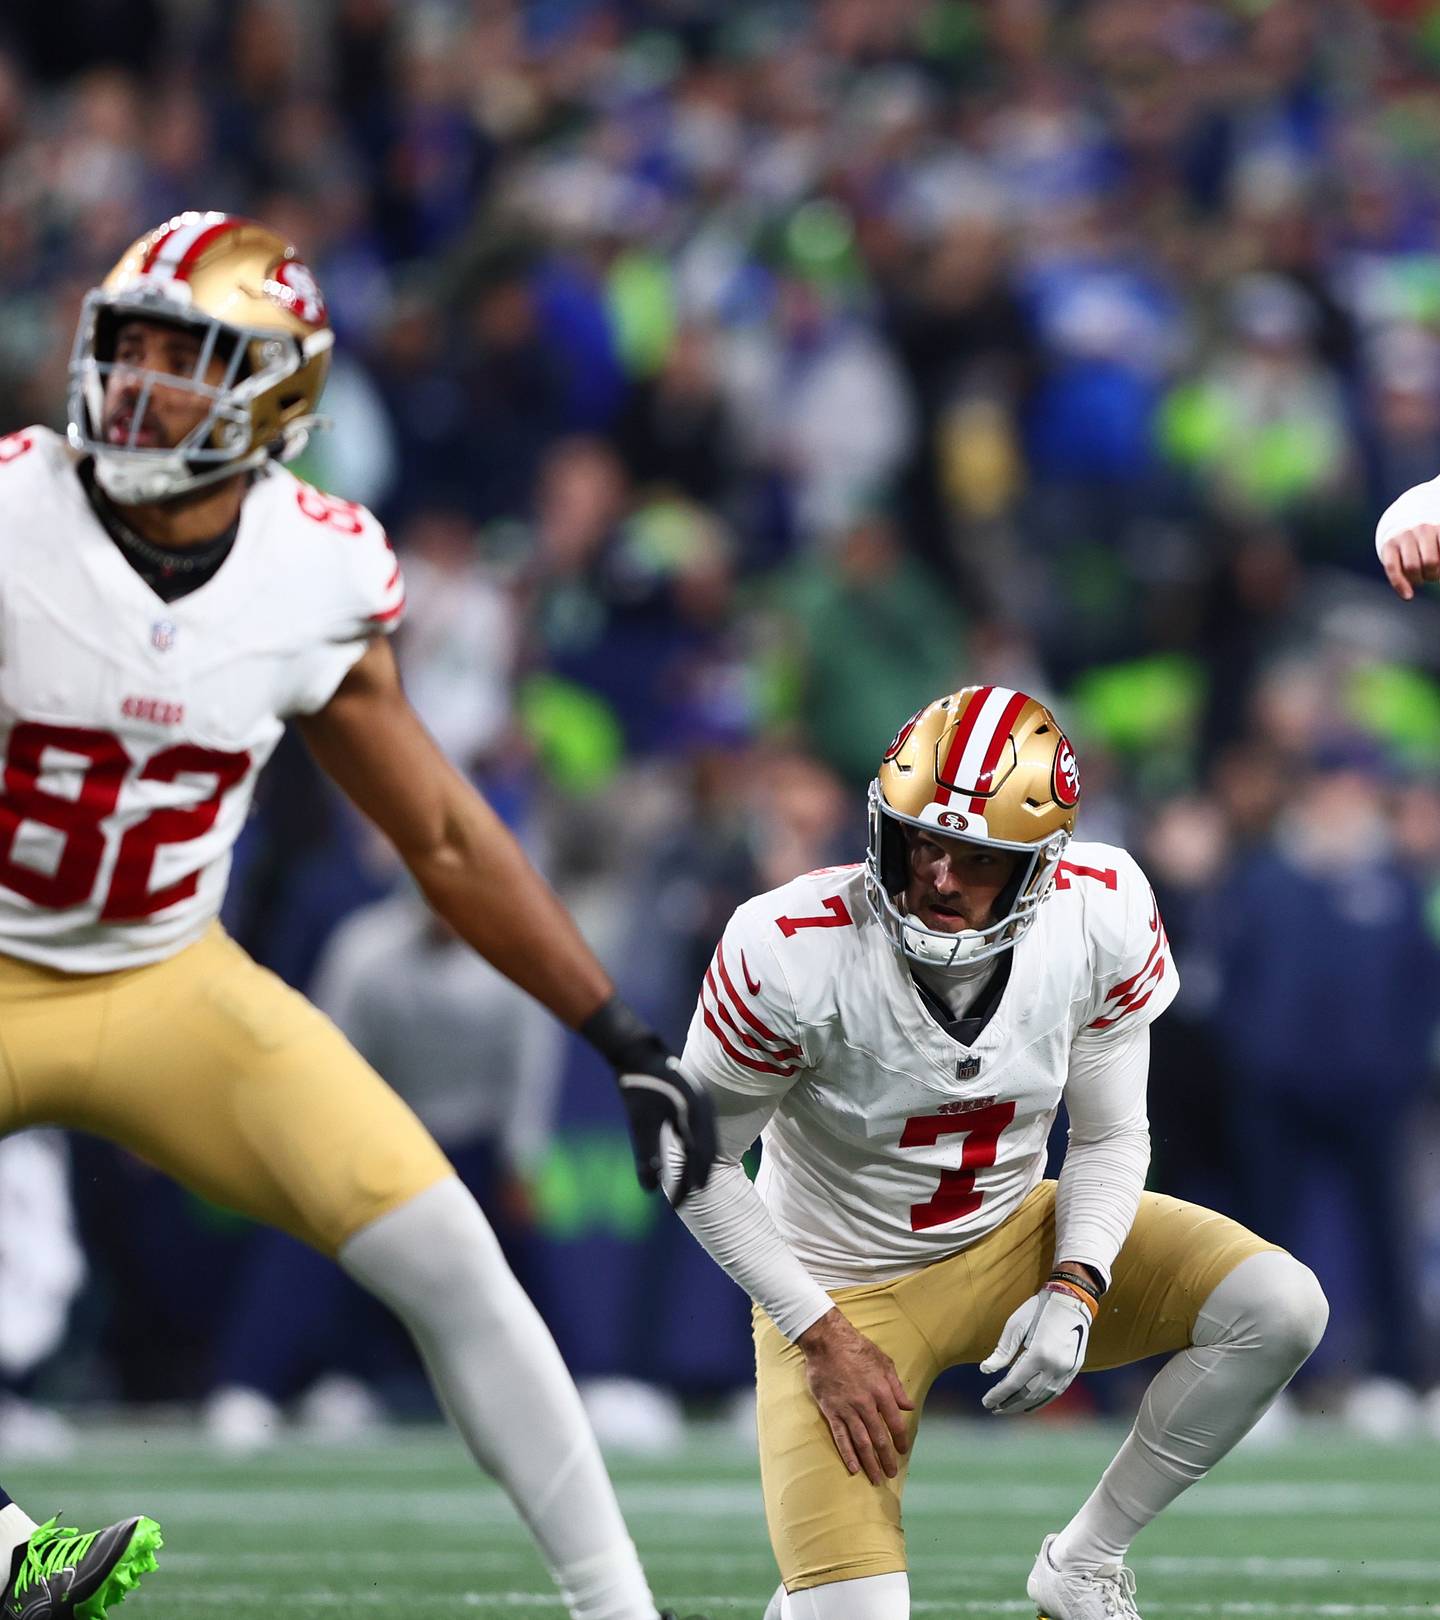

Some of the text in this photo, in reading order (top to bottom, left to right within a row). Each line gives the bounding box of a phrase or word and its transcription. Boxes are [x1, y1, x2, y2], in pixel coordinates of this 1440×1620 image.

[0, 720, 254, 925] 82
[775, 895, 853, 938] 7
[1054, 860, 1117, 890] 7
[899, 1101, 1016, 1232] 7
